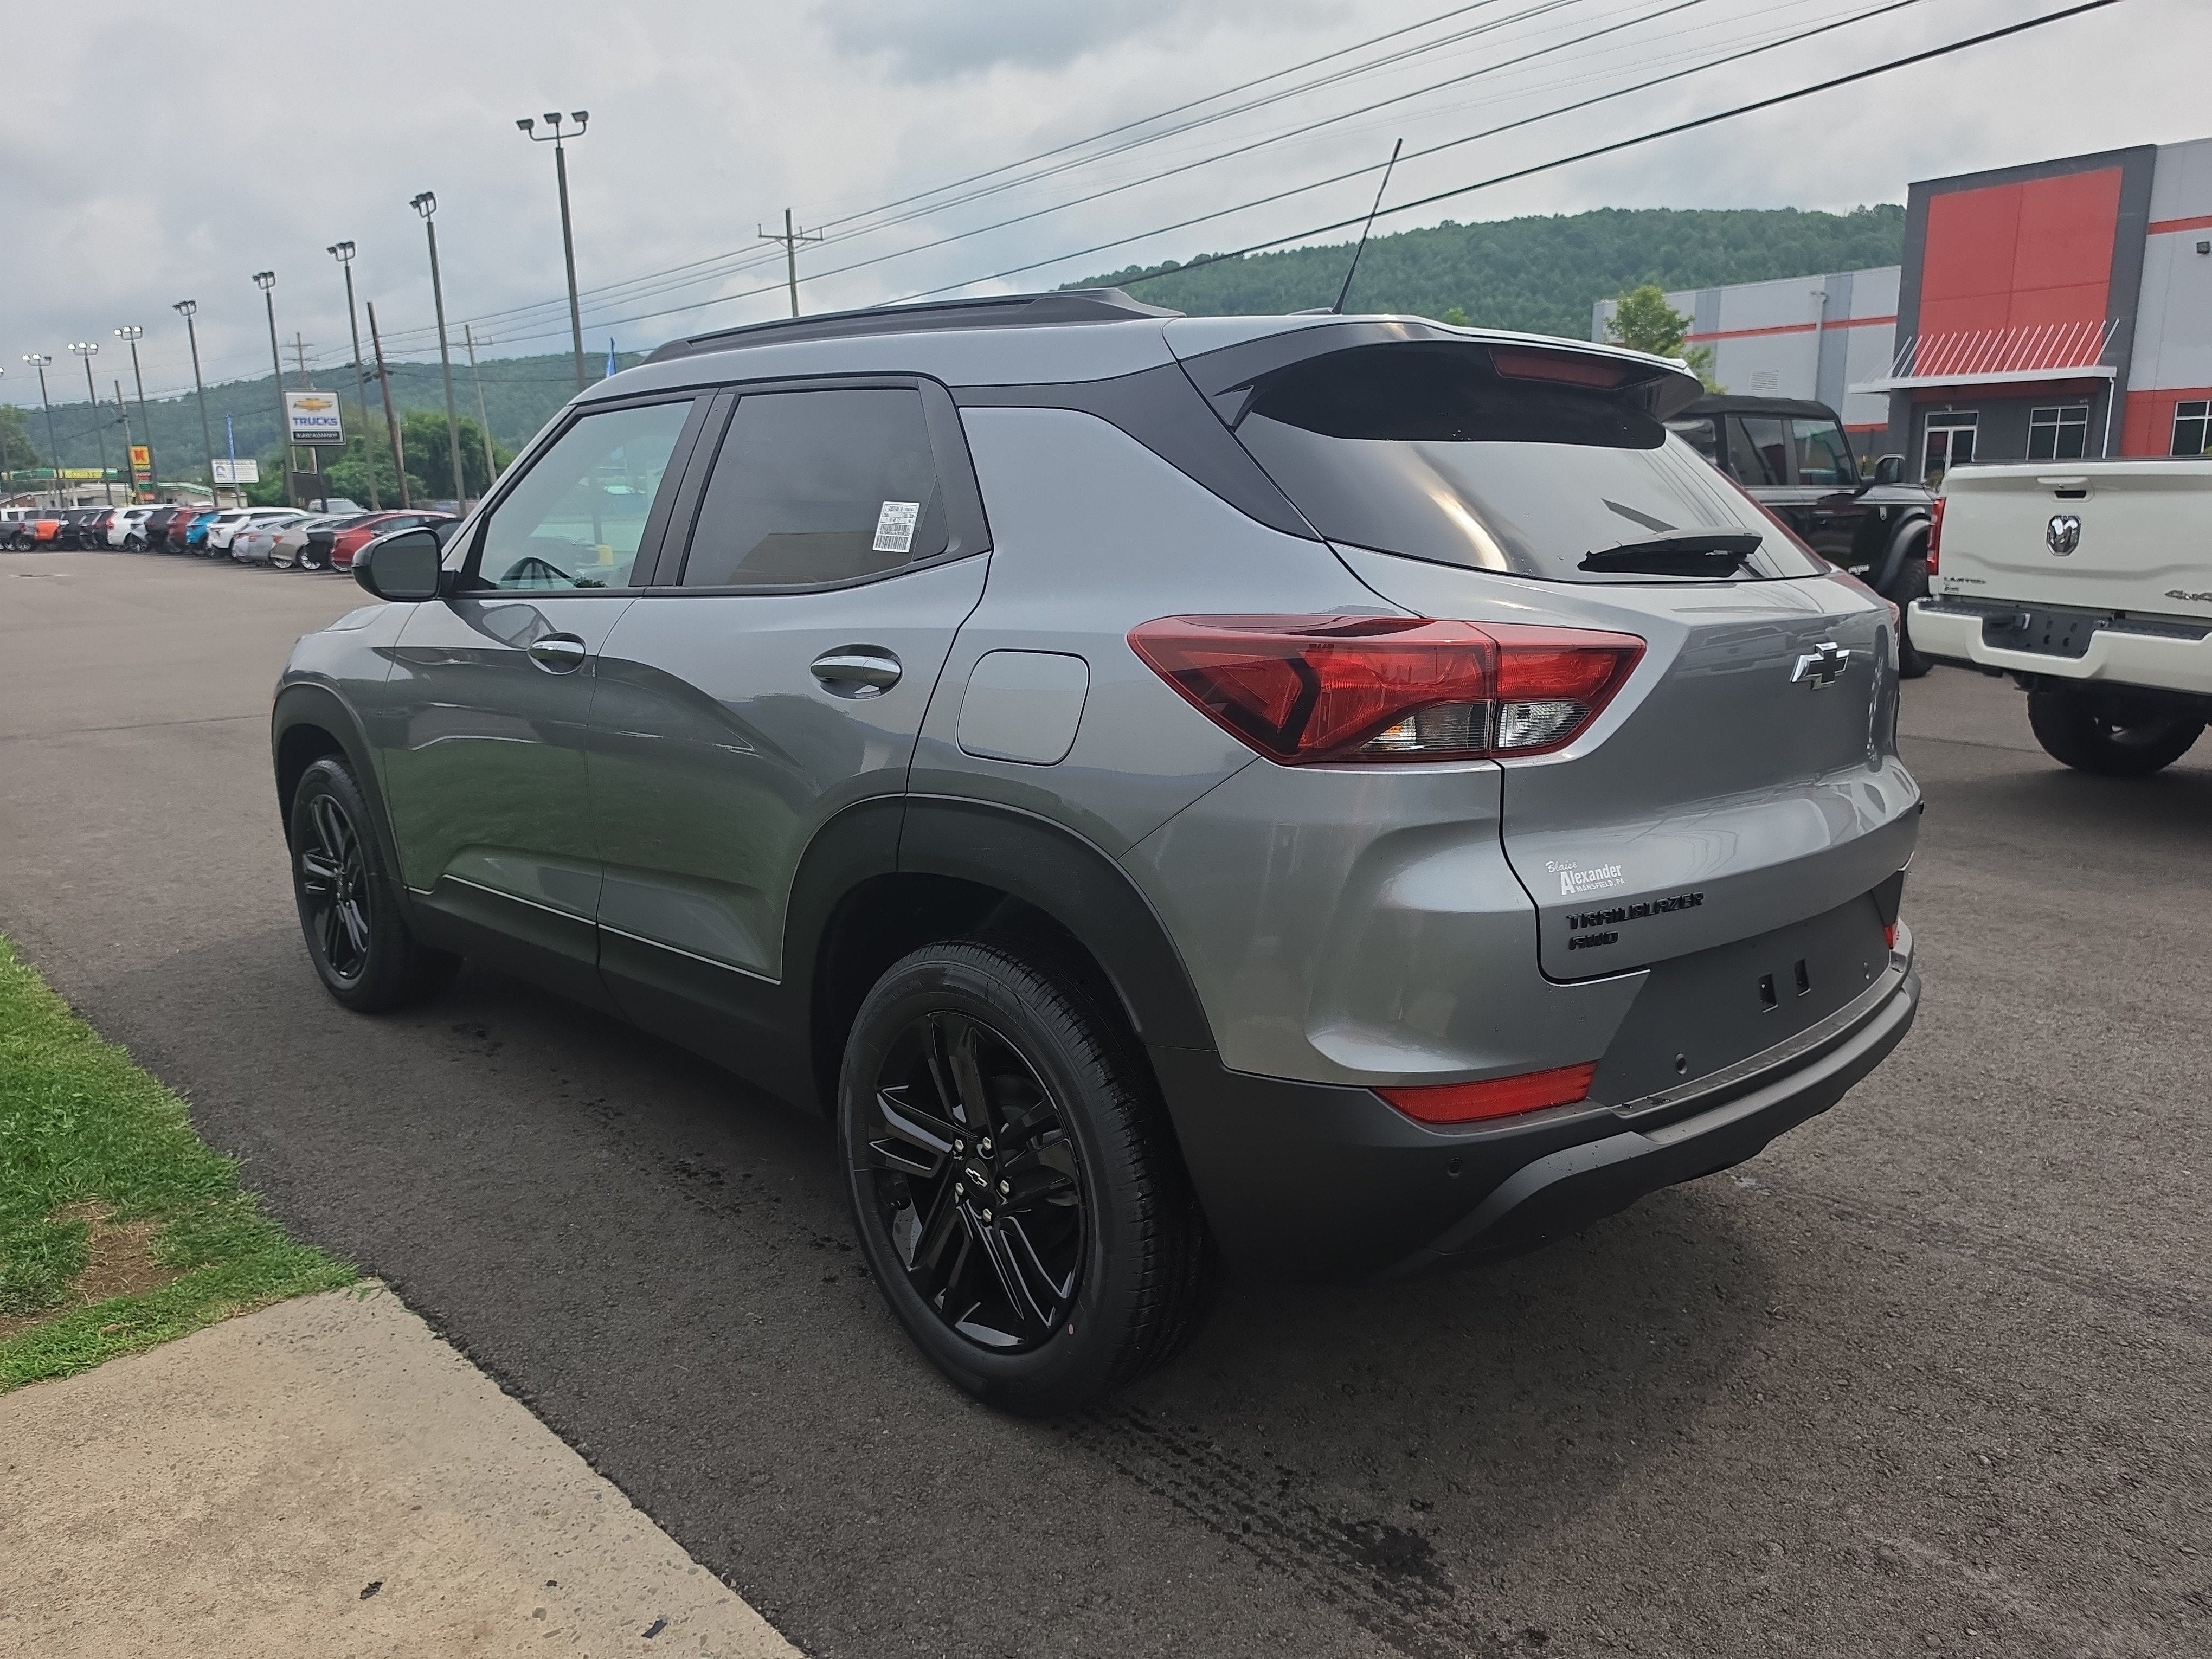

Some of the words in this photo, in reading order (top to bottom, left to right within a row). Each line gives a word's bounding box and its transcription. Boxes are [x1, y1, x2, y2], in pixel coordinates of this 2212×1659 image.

[293, 417, 338, 426] TRUCKS
[1546, 861, 1578, 873] Blaise
[1560, 864, 1622, 895] Alexander
[1576, 880, 1616, 892] MANSFIELD,
[1566, 892, 1704, 930] TRAILBLAZER
[1569, 931, 1618, 950] AWD
